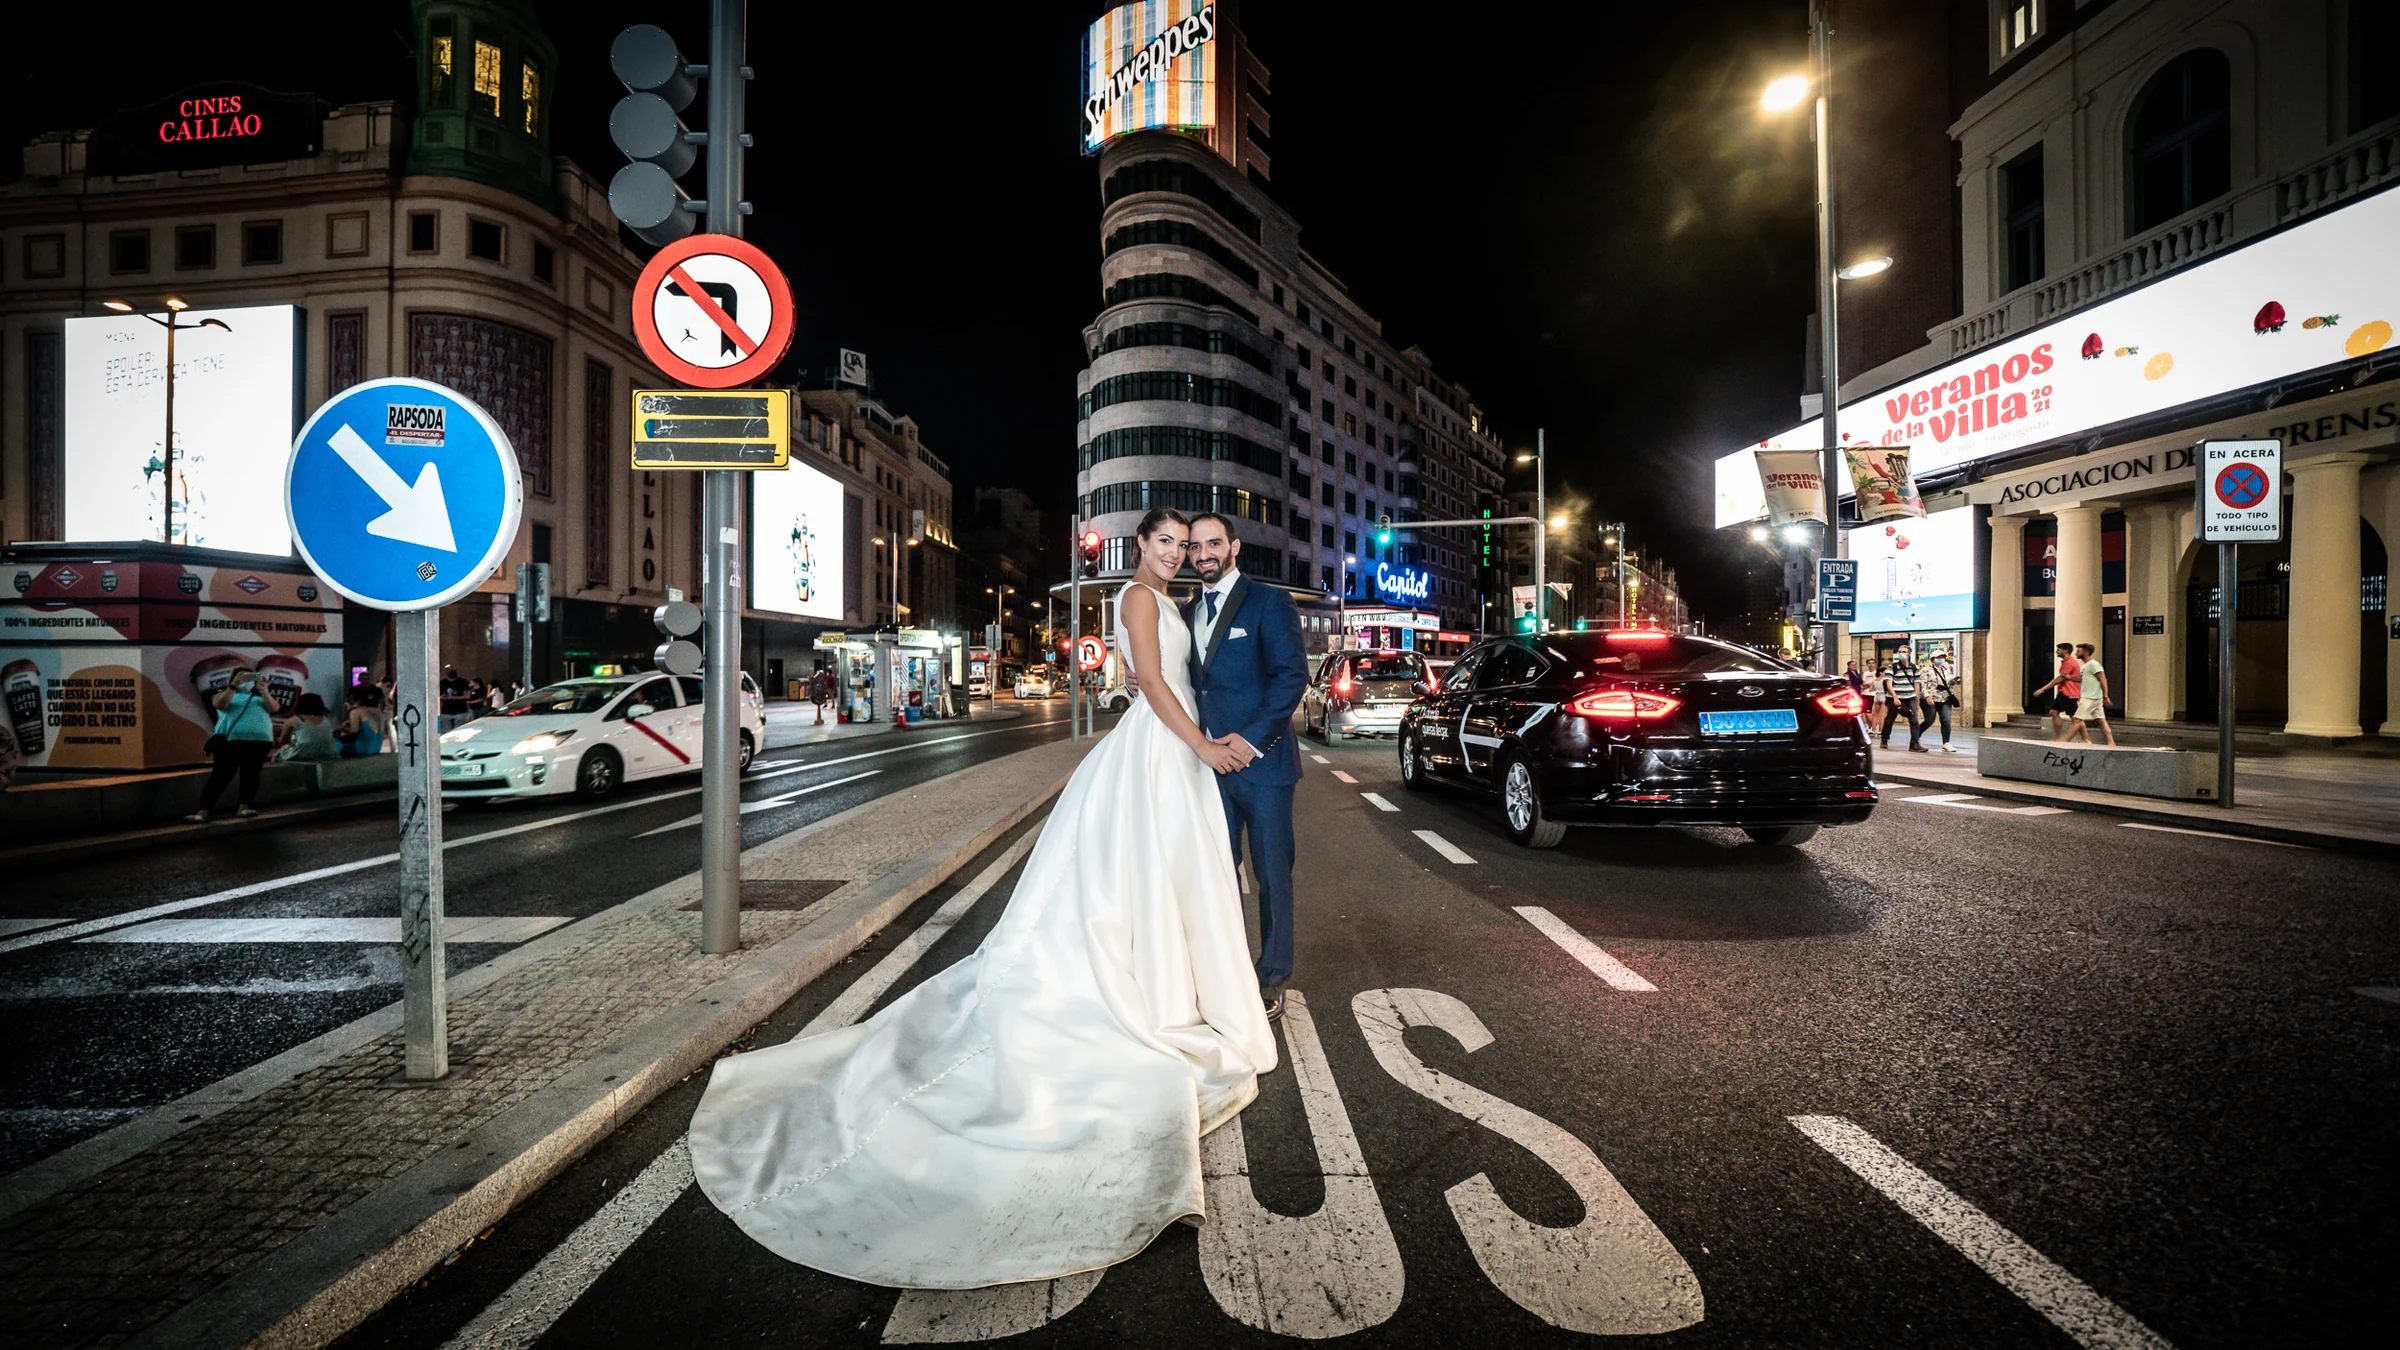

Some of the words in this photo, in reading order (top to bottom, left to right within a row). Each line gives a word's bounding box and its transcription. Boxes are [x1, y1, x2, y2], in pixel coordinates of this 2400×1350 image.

[1085, 5, 1214, 141] Schweppes
[180, 96, 242, 117] CINES
[160, 114, 262, 142] CALLAO
[137, 363, 188, 387] CERVZA
[2031, 385, 2053, 401] 20
[2034, 399, 2051, 413] 21
[388, 406, 444, 430] RAPSODA
[1881, 427, 1903, 447] de
[1906, 422, 1924, 440] la
[2209, 450, 2226, 459] EN
[2233, 449, 2275, 458] ACERA
[1999, 455, 2153, 505] ASOCIACION
[2216, 512, 2242, 520] TODO
[643, 470, 656, 581] LLAO
[2224, 523, 2277, 532] VEHÍCULOS
[1823, 562, 1854, 574] ENTRADA
[2277, 562, 2291, 572] 46
[1377, 562, 1428, 599] Capitol
[1825, 574, 1851, 587] P
[4, 617, 27, 627] 100%
[28, 617, 84, 628] INGREDIENTES
[85, 617, 130, 627] NATURALES
[200, 619, 273, 631] INGREDIENTES
[275, 622, 327, 633] NATURALES
[47, 679, 61, 687] TAN
[62, 679, 92, 687] NATURAL
[93, 679, 113, 687] COMO
[114, 679, 135, 687] DECIR
[47, 689, 64, 700] QUE
[65, 688, 90, 699] ESTÁS
[92, 689, 136, 700] LLEGANDO
[14, 701, 37, 712] LATTE
[47, 702, 83, 712] CUANDO
[104, 702, 117, 713] NO
[118, 702, 136, 713] HAS
[48, 714, 85, 727] COGIDO
[87, 715, 99, 727] EL
[101, 715, 137, 727] METRO
